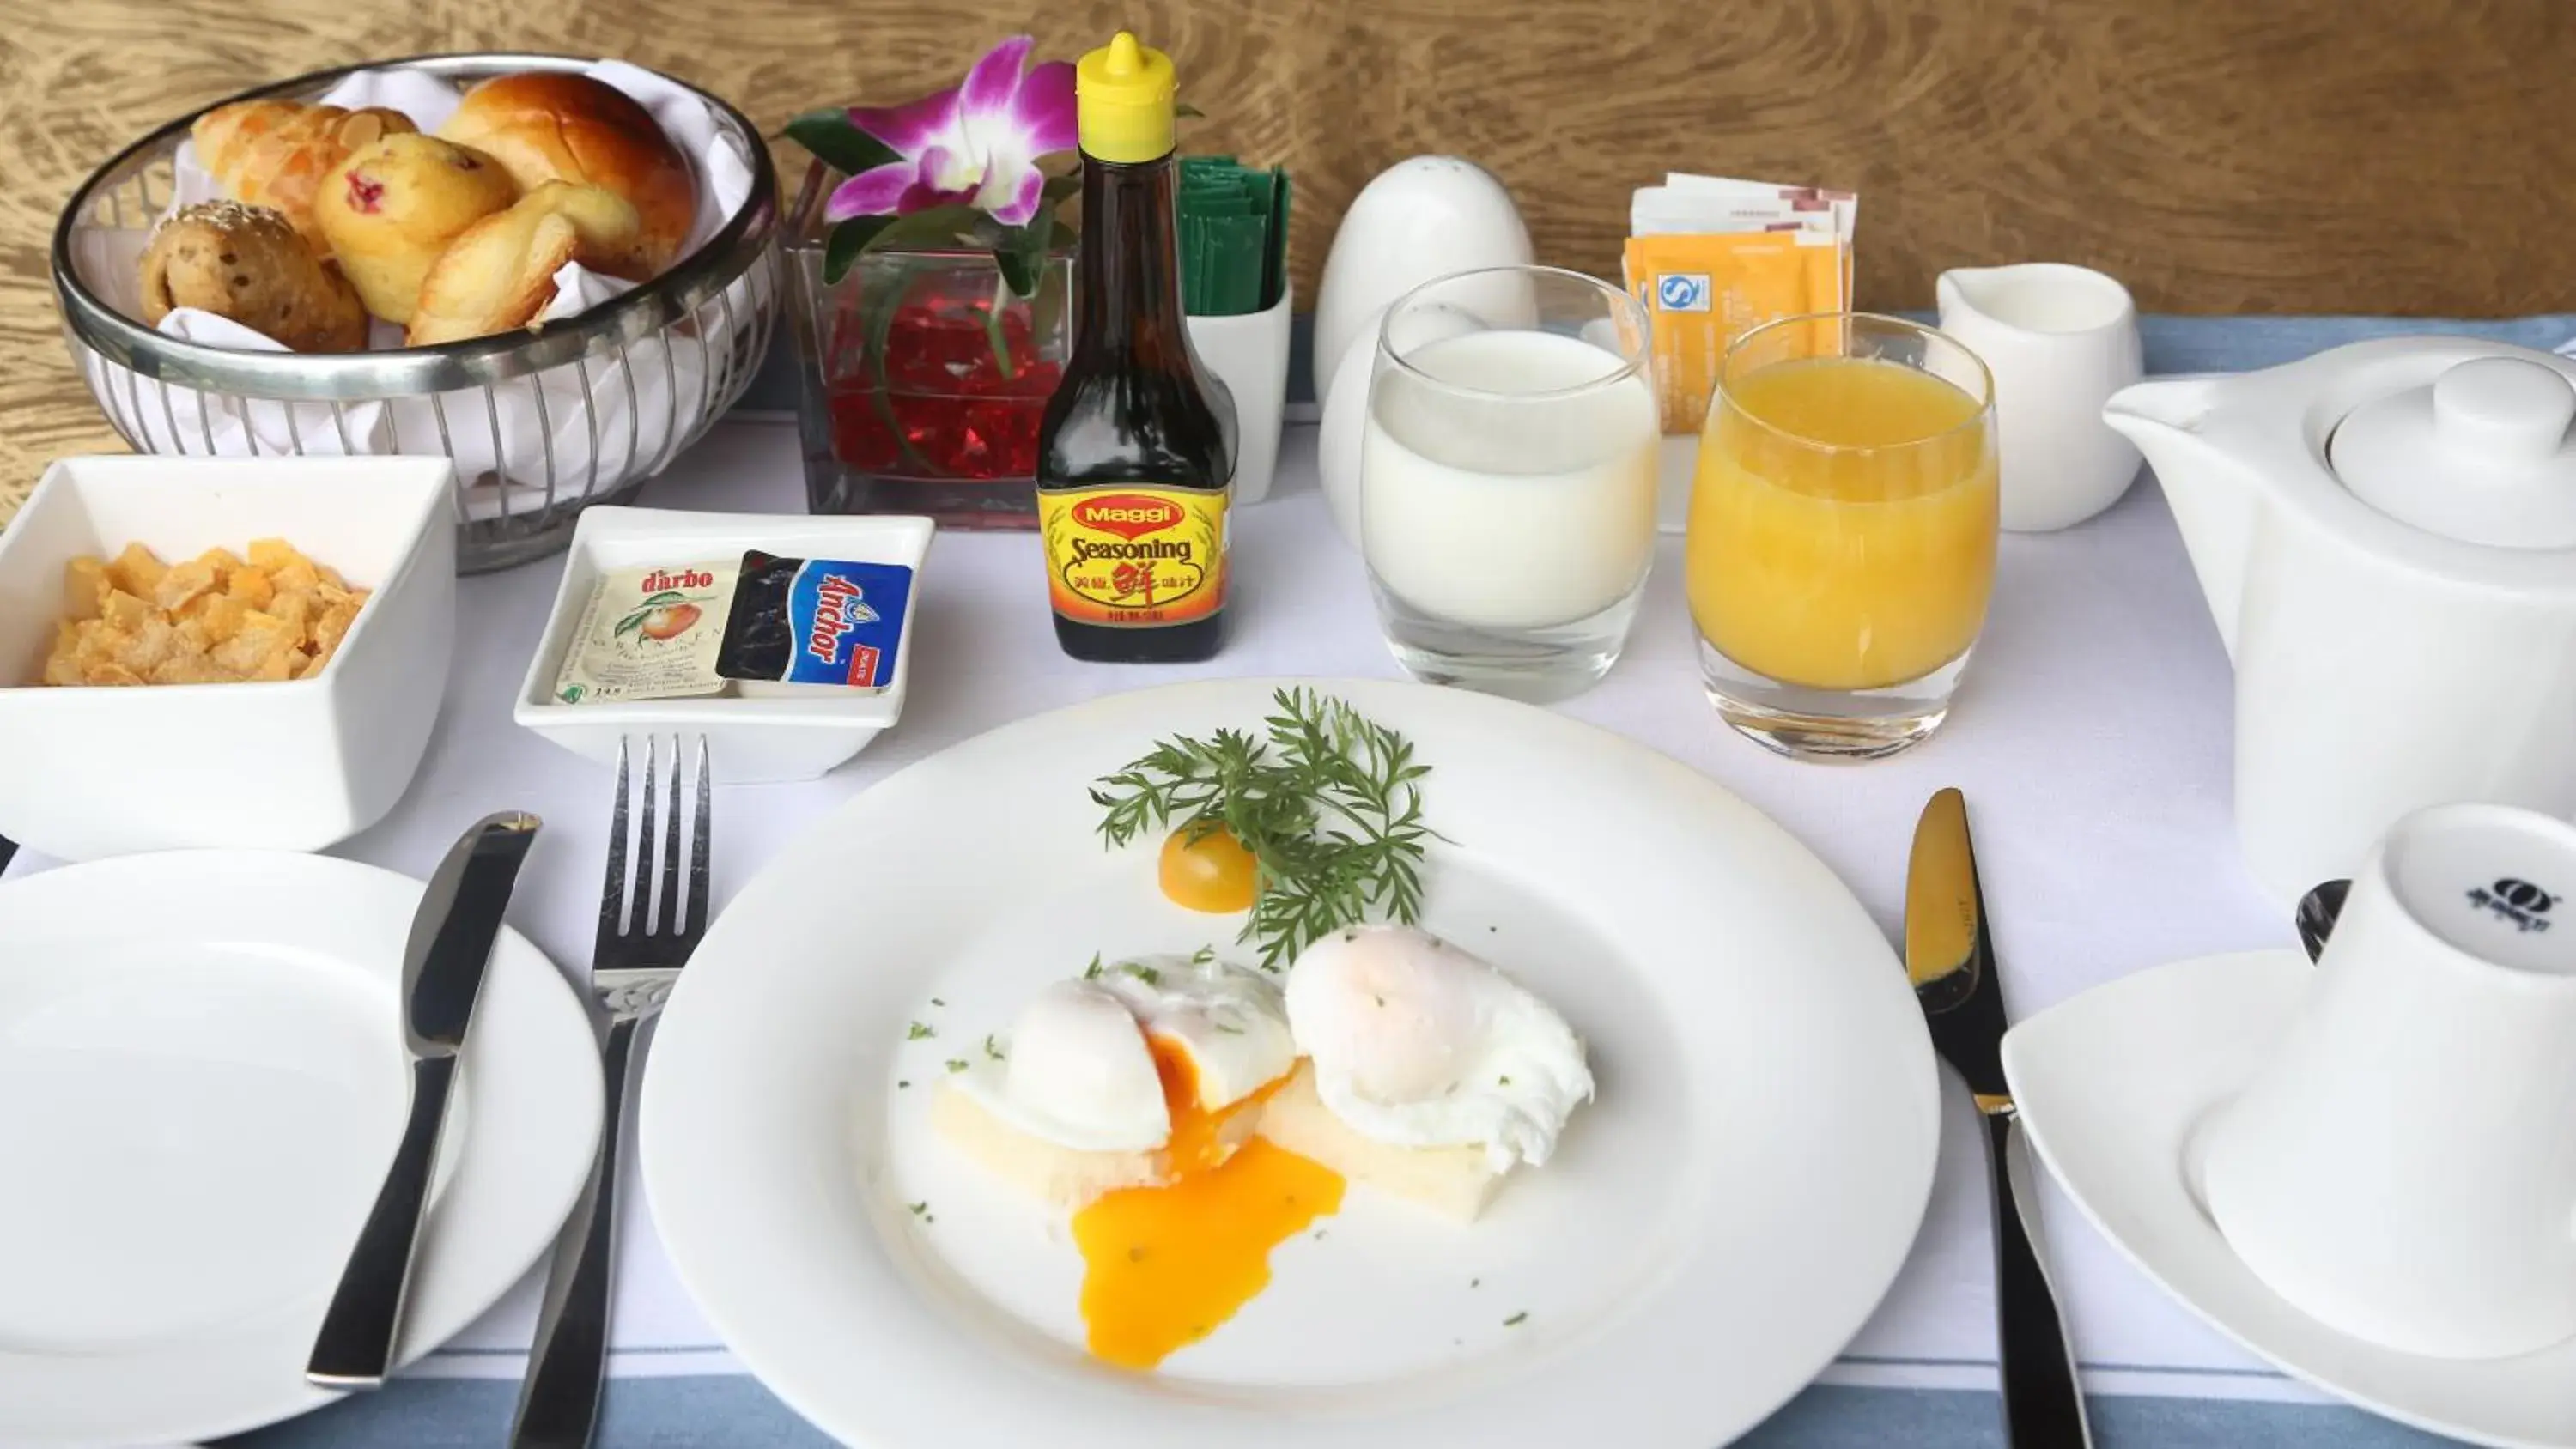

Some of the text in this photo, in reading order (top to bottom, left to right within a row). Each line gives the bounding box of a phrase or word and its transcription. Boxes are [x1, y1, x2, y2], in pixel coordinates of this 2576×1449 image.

[1084, 506, 1172, 524] Maggi
[1071, 537, 1192, 563] Seasoning
[809, 574, 862, 664] Anchor
